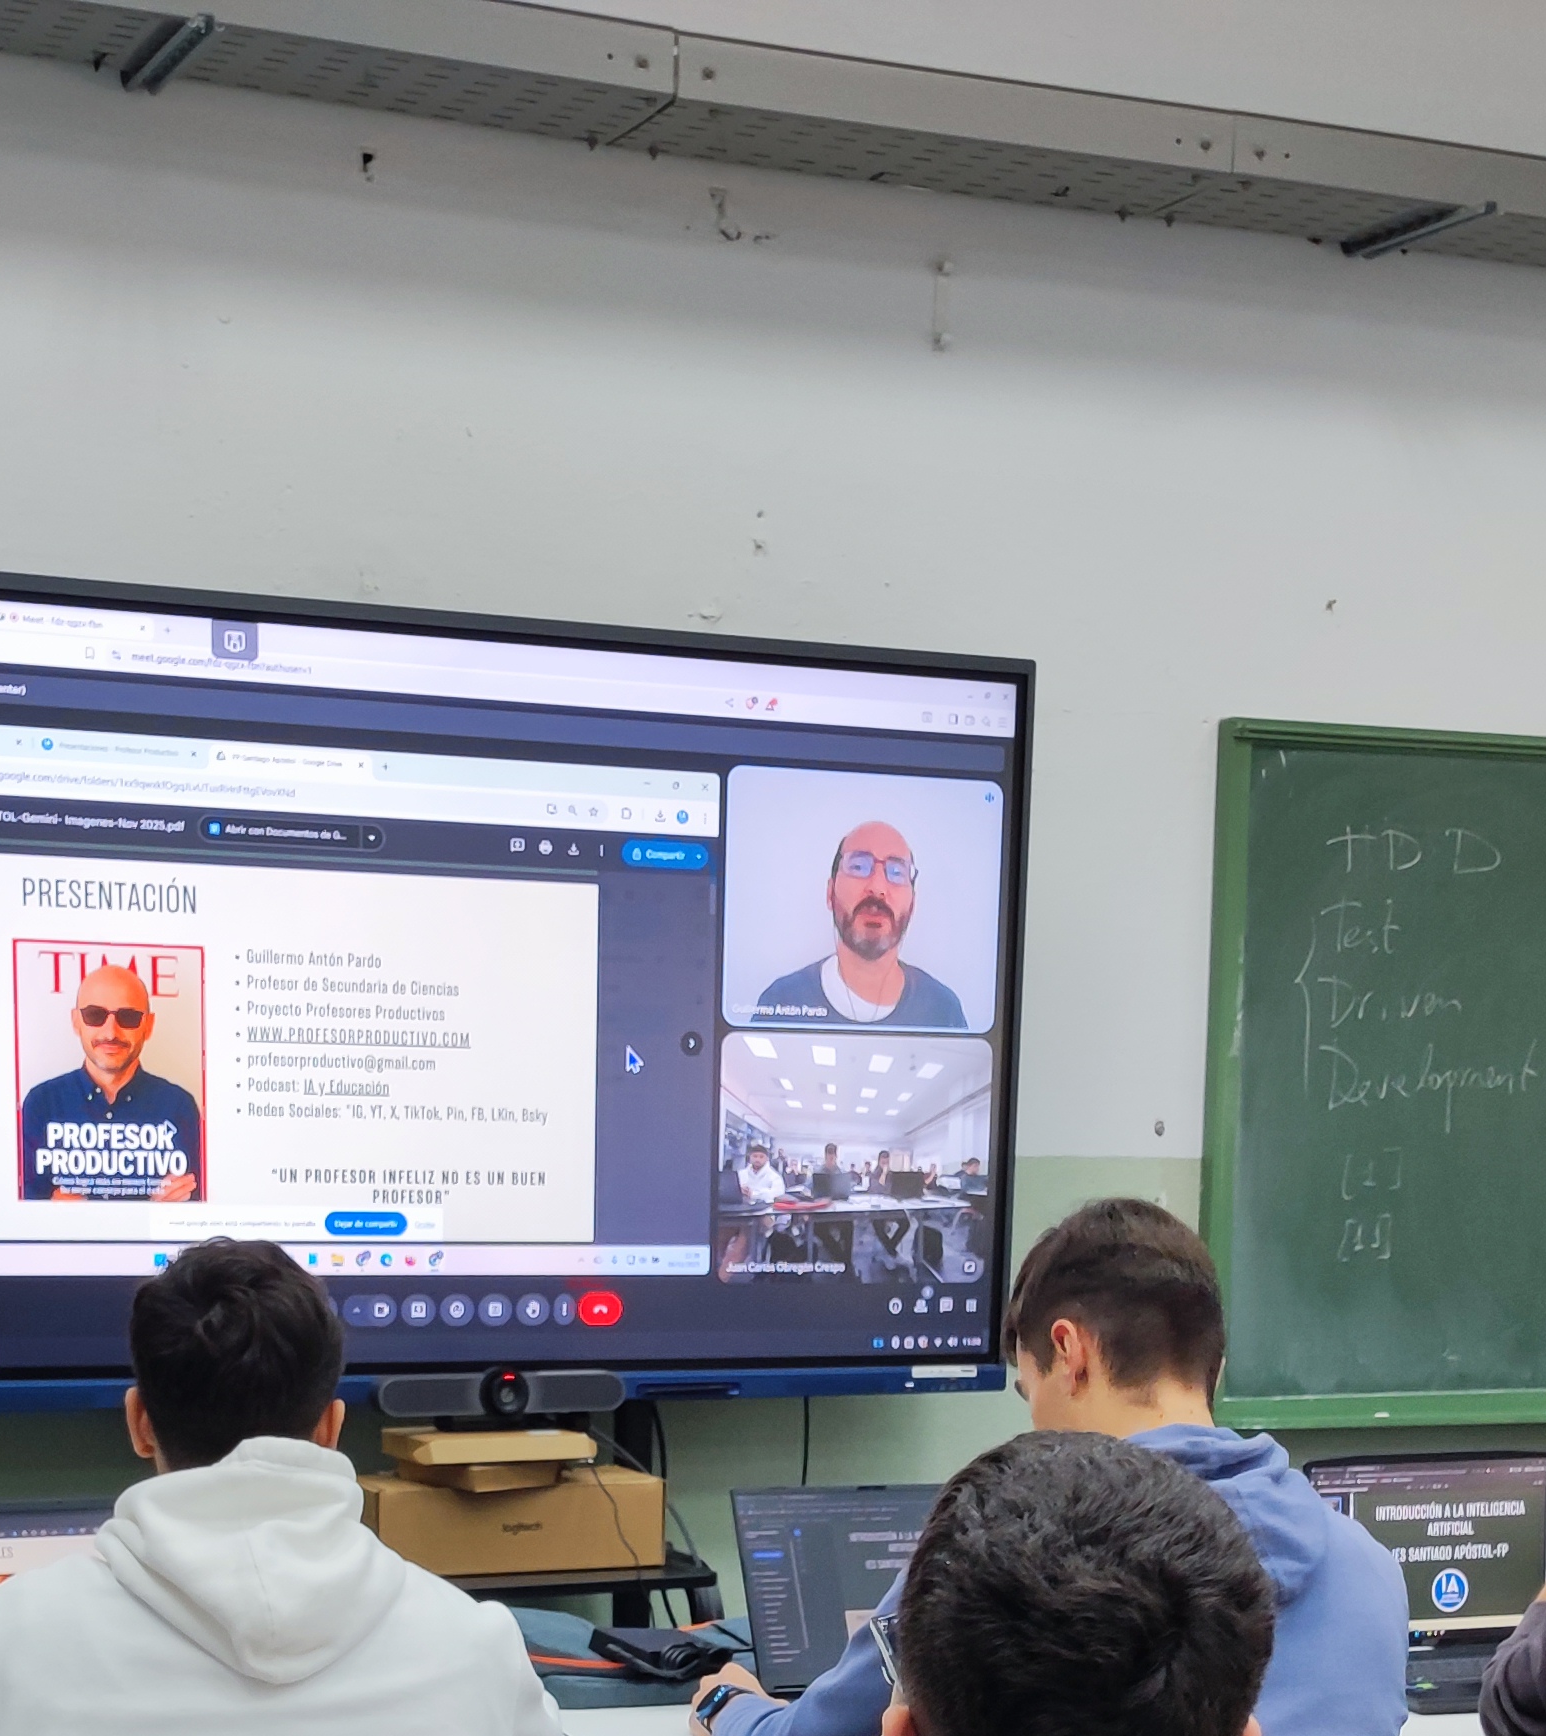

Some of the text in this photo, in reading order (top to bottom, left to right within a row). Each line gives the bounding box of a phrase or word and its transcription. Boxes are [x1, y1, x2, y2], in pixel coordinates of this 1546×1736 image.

[22, 877, 197, 914] PRESENTACIÓN
[1320, 896, 1401, 954] Test
[247, 949, 381, 968] Guillermo Antón Pardo
[38, 950, 180, 997] TIE
[247, 975, 460, 997] Profesor de Secundaria de Ciencias
[247, 1001, 445, 1021] Proyecto Profesores Productivos
[247, 1026, 471, 1049] WWW.PROFESORPRODUCTIVO.COM
[247, 1052, 436, 1073] profesorproductivo@gmail.com
[248, 1077, 300, 1093] Podcast:
[303, 1079, 316, 1095] IA
[328, 1079, 390, 1097] Educación
[1318, 1037, 1538, 1135] Development
[248, 1103, 285, 1117] Redes
[289, 1104, 342, 1119] Sociales:
[370, 1105, 387, 1120] YT,
[389, 1107, 400, 1121] X,
[404, 1106, 443, 1121] TikTok,
[447, 1107, 467, 1122] Pin,
[471, 1107, 487, 1122] FB,
[522, 1109, 548, 1126] Bsky
[46, 1122, 175, 1150] PROFESOR
[36, 1149, 188, 1176] PRODUCTIVO
[304, 1168, 377, 1185] PROFESOR
[382, 1169, 435, 1185] INFELIZ
[441, 1170, 459, 1186] NO
[465, 1170, 481, 1186] ES
[487, 1171, 505, 1186] UN
[511, 1171, 547, 1187] BUEN
[372, 1189, 450, 1205] PROFESOR"
[1375, 1501, 1443, 1521] INTRODUCCIÓN
[1453, 1503, 1464, 1518] LA
[1466, 1500, 1526, 1518] INTELIGENCIA
[1427, 1520, 1475, 1537] ARTIFICIAL
[1408, 1545, 1452, 1562] SANTIAGO
